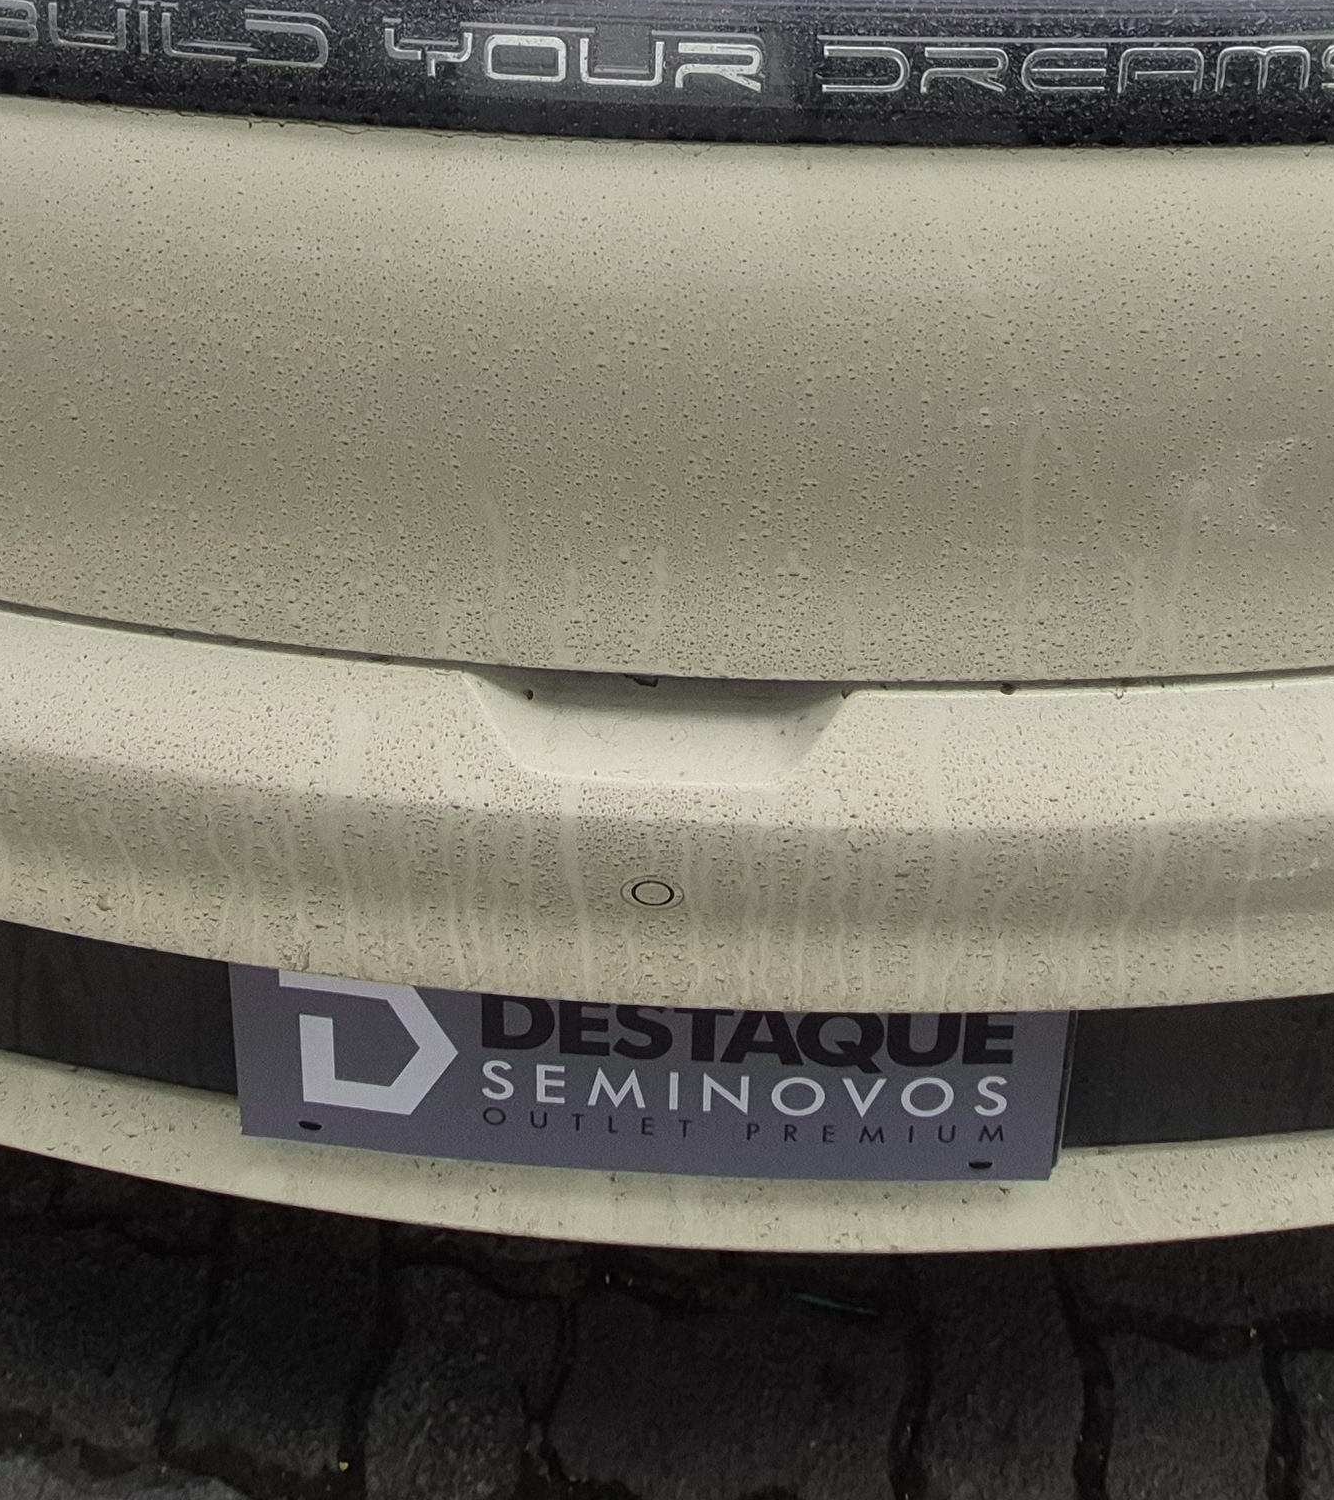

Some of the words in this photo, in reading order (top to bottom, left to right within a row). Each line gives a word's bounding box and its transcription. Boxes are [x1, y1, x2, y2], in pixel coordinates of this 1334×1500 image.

[383, 21, 763, 94] YOUR
[481, 993, 1014, 1074] DESTAQUE
[481, 1059, 1008, 1118] SEMINOVOS
[482, 1106, 693, 1138] OUTLET
[746, 1122, 1004, 1144] PREMIUM
